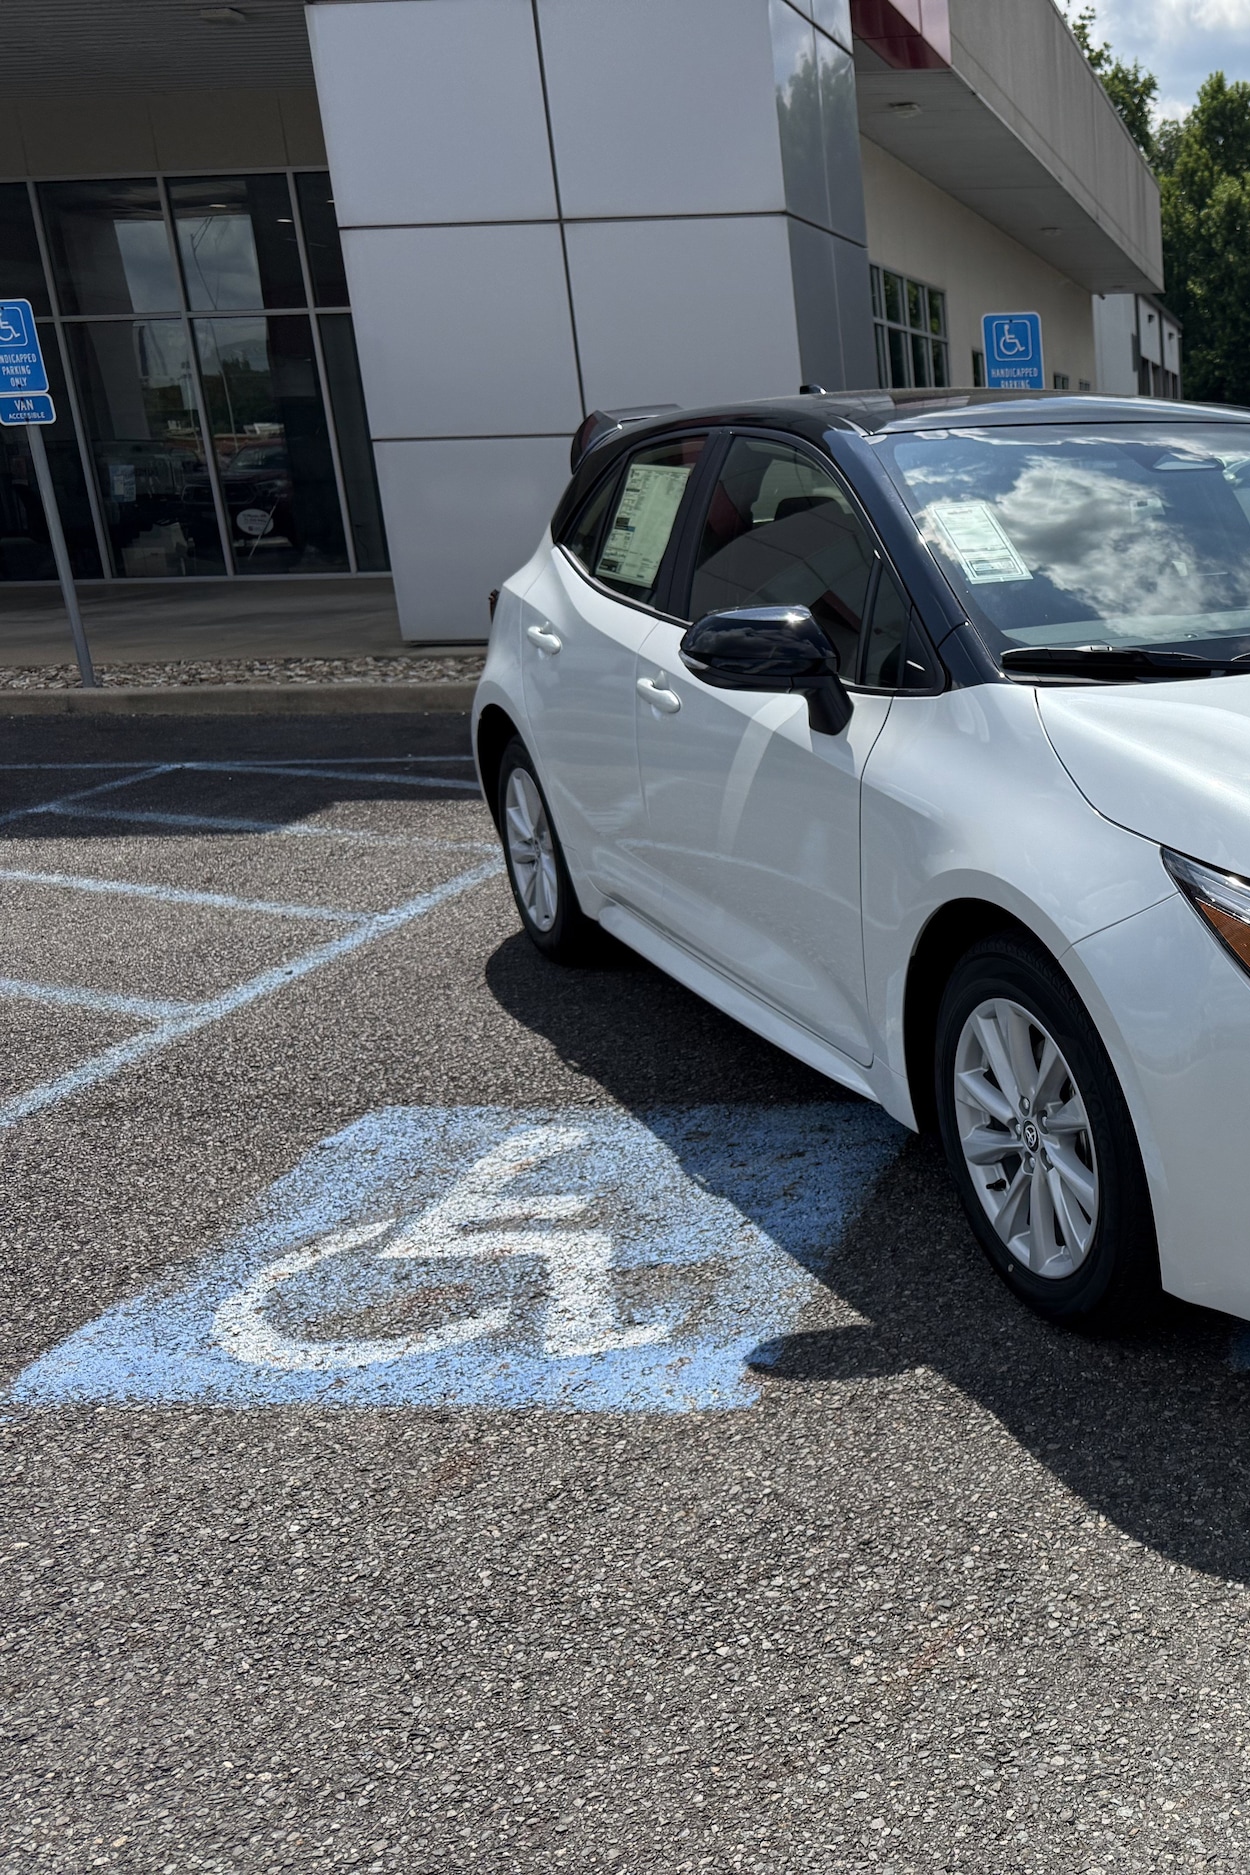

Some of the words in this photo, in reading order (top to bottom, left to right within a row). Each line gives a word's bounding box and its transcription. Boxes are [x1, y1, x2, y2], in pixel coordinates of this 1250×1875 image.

[0, 353, 37, 363] NDICAPPED
[1, 365, 31, 375] PARKING
[991, 368, 1038, 377] HANDICAPPED
[10, 377, 27, 387] ONLY
[1000, 380, 1030, 389] PARKING
[14, 400, 34, 411] VAN
[8, 412, 45, 420] ACCESSIBLE
